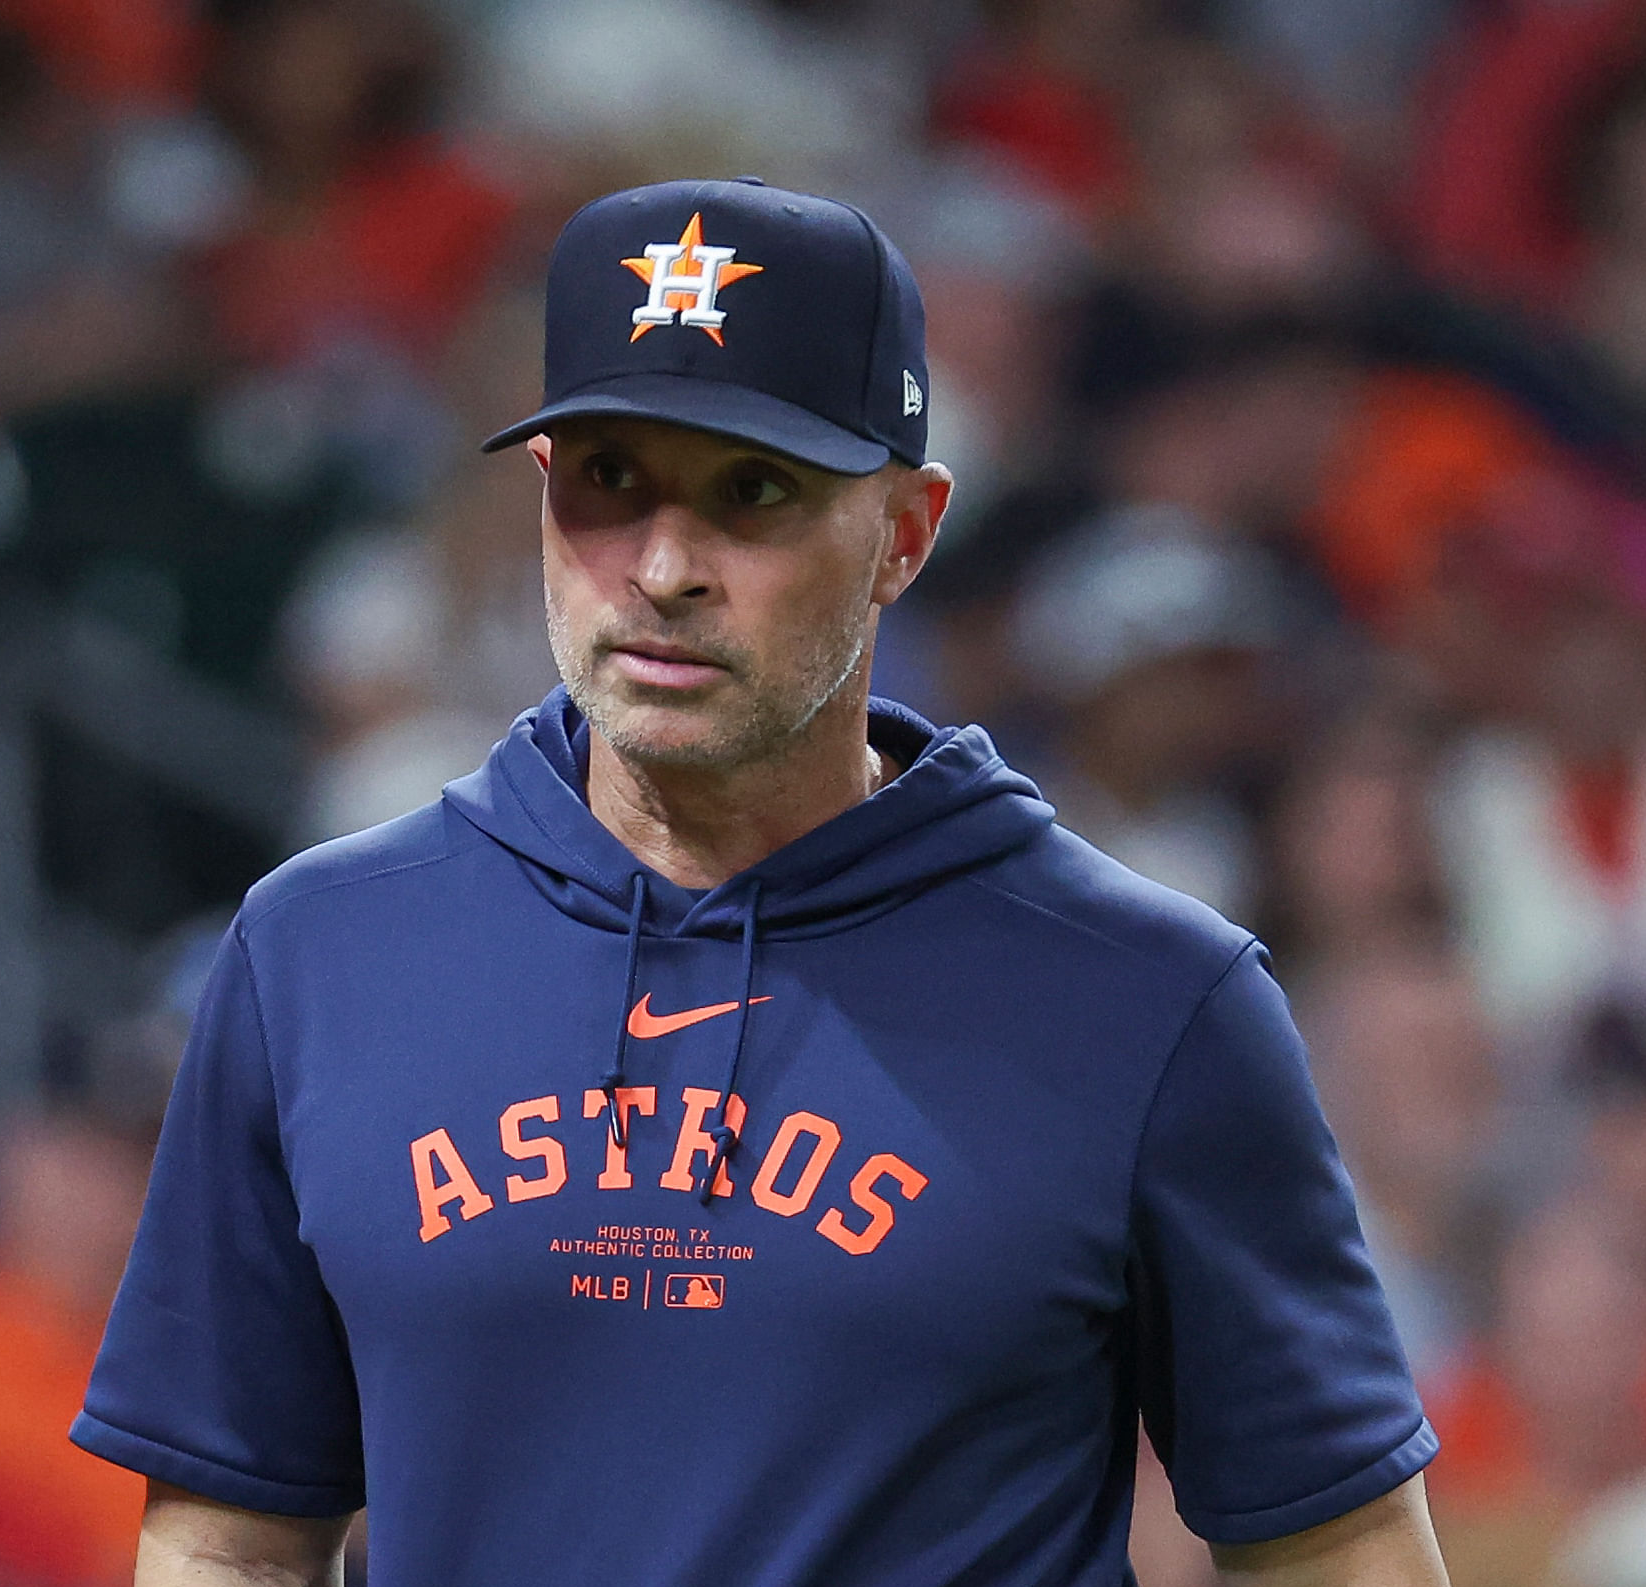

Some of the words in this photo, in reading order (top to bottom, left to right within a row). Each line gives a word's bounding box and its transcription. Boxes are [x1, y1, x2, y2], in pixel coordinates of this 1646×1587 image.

[632, 243, 737, 327] H
[410, 1086, 929, 1255] ASTROS
[688, 1229, 711, 1242] TX
[550, 1239, 646, 1257] AUTHENTIC
[652, 1244, 754, 1260] COLLECTION
[571, 1274, 631, 1300] MLB
